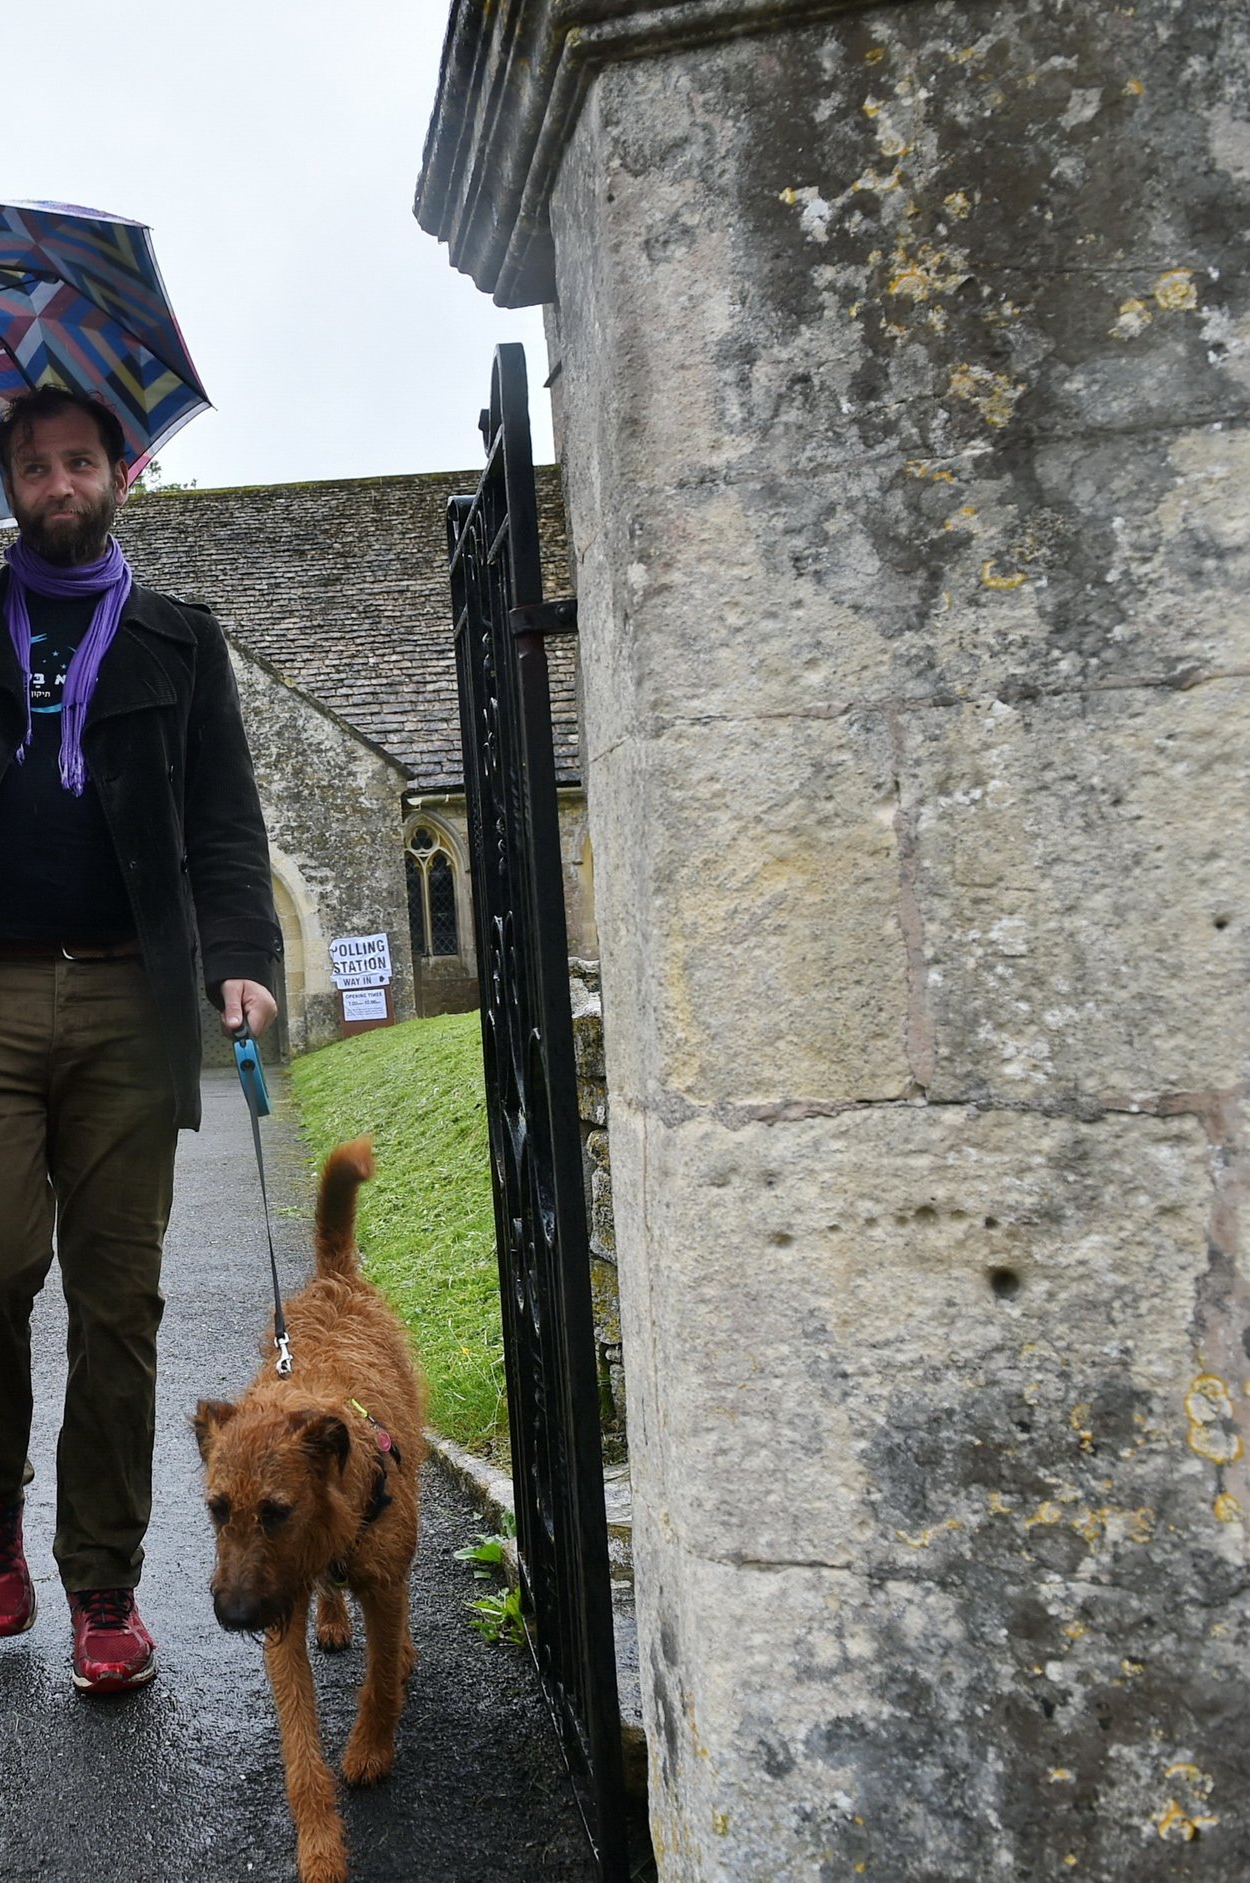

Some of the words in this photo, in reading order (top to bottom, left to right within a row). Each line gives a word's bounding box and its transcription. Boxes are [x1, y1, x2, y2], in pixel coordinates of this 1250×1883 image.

[31, 690, 51, 698] תיקון
[333, 956, 387, 974] STATION
[343, 977, 360, 987] WAY
[363, 976, 372, 985] IN
